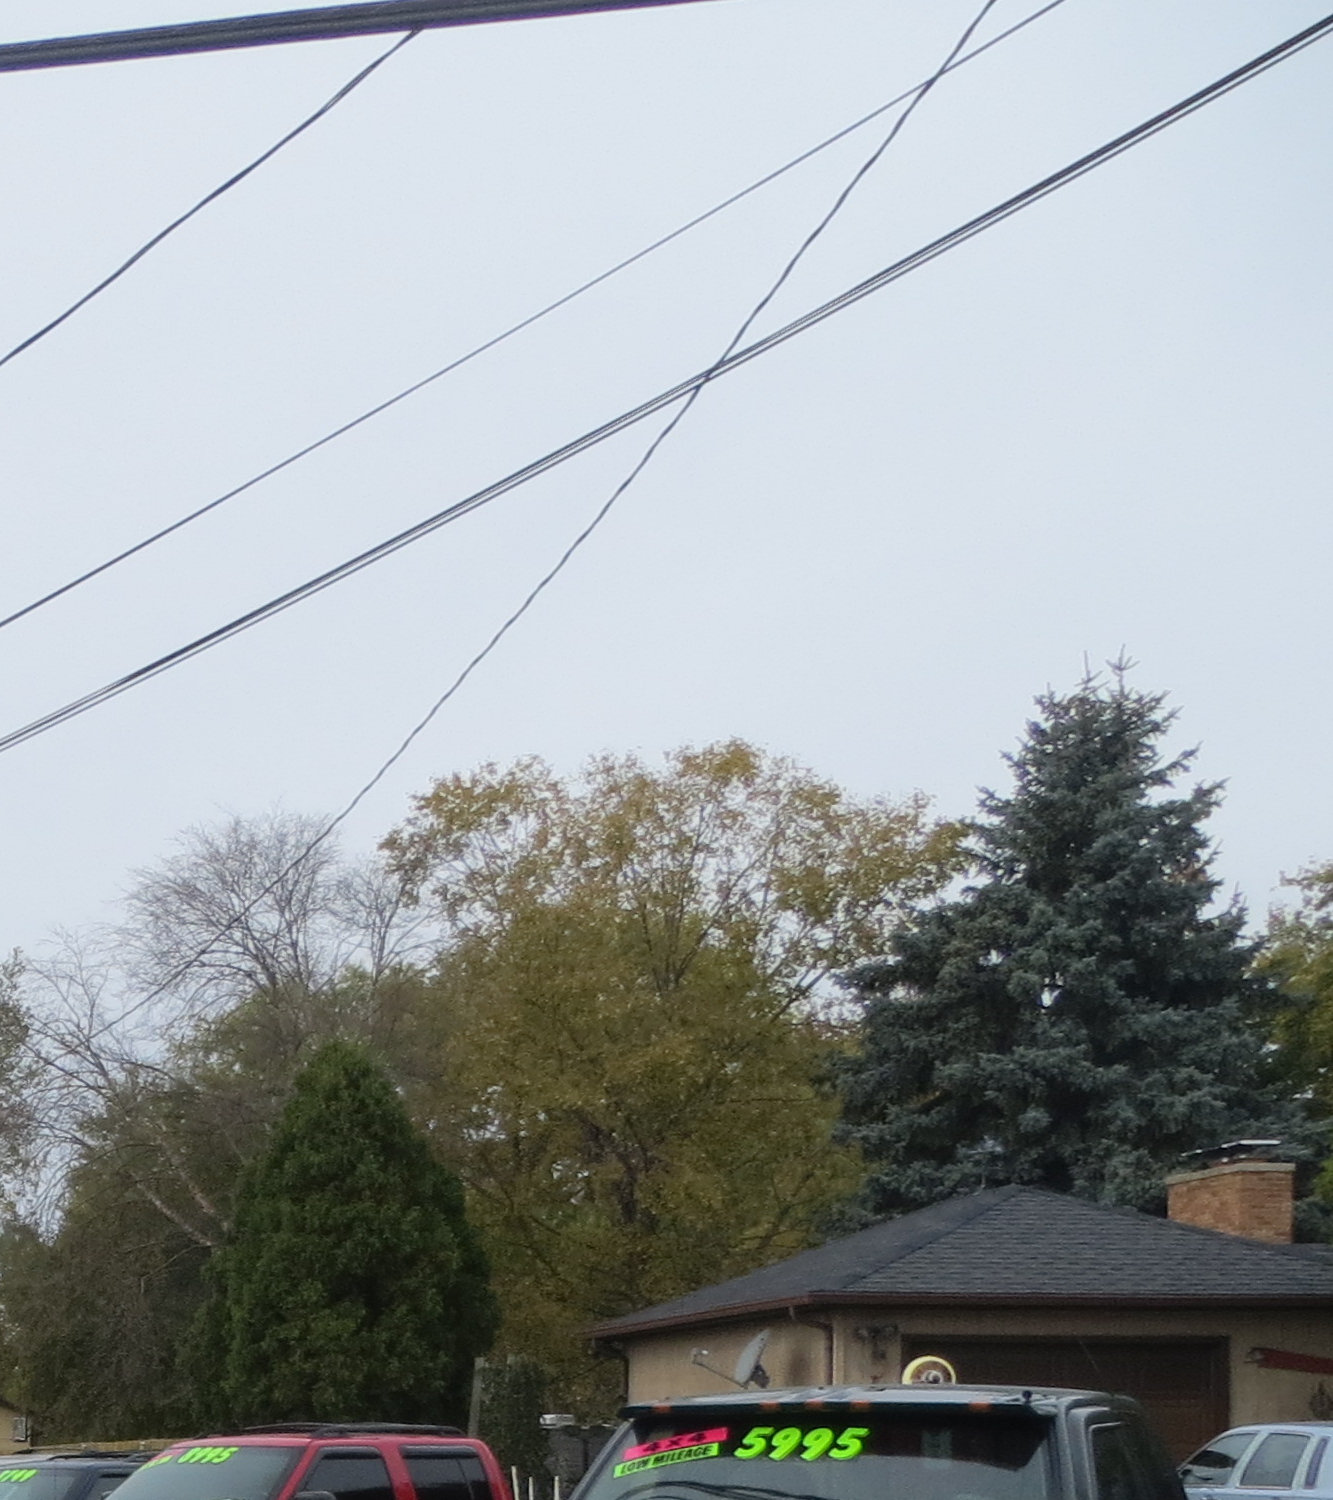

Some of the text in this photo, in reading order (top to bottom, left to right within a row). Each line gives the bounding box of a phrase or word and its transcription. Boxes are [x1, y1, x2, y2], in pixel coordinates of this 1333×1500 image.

[620, 1445, 714, 1474] LOW MILEAGE
[734, 1427, 871, 1461] 5995
